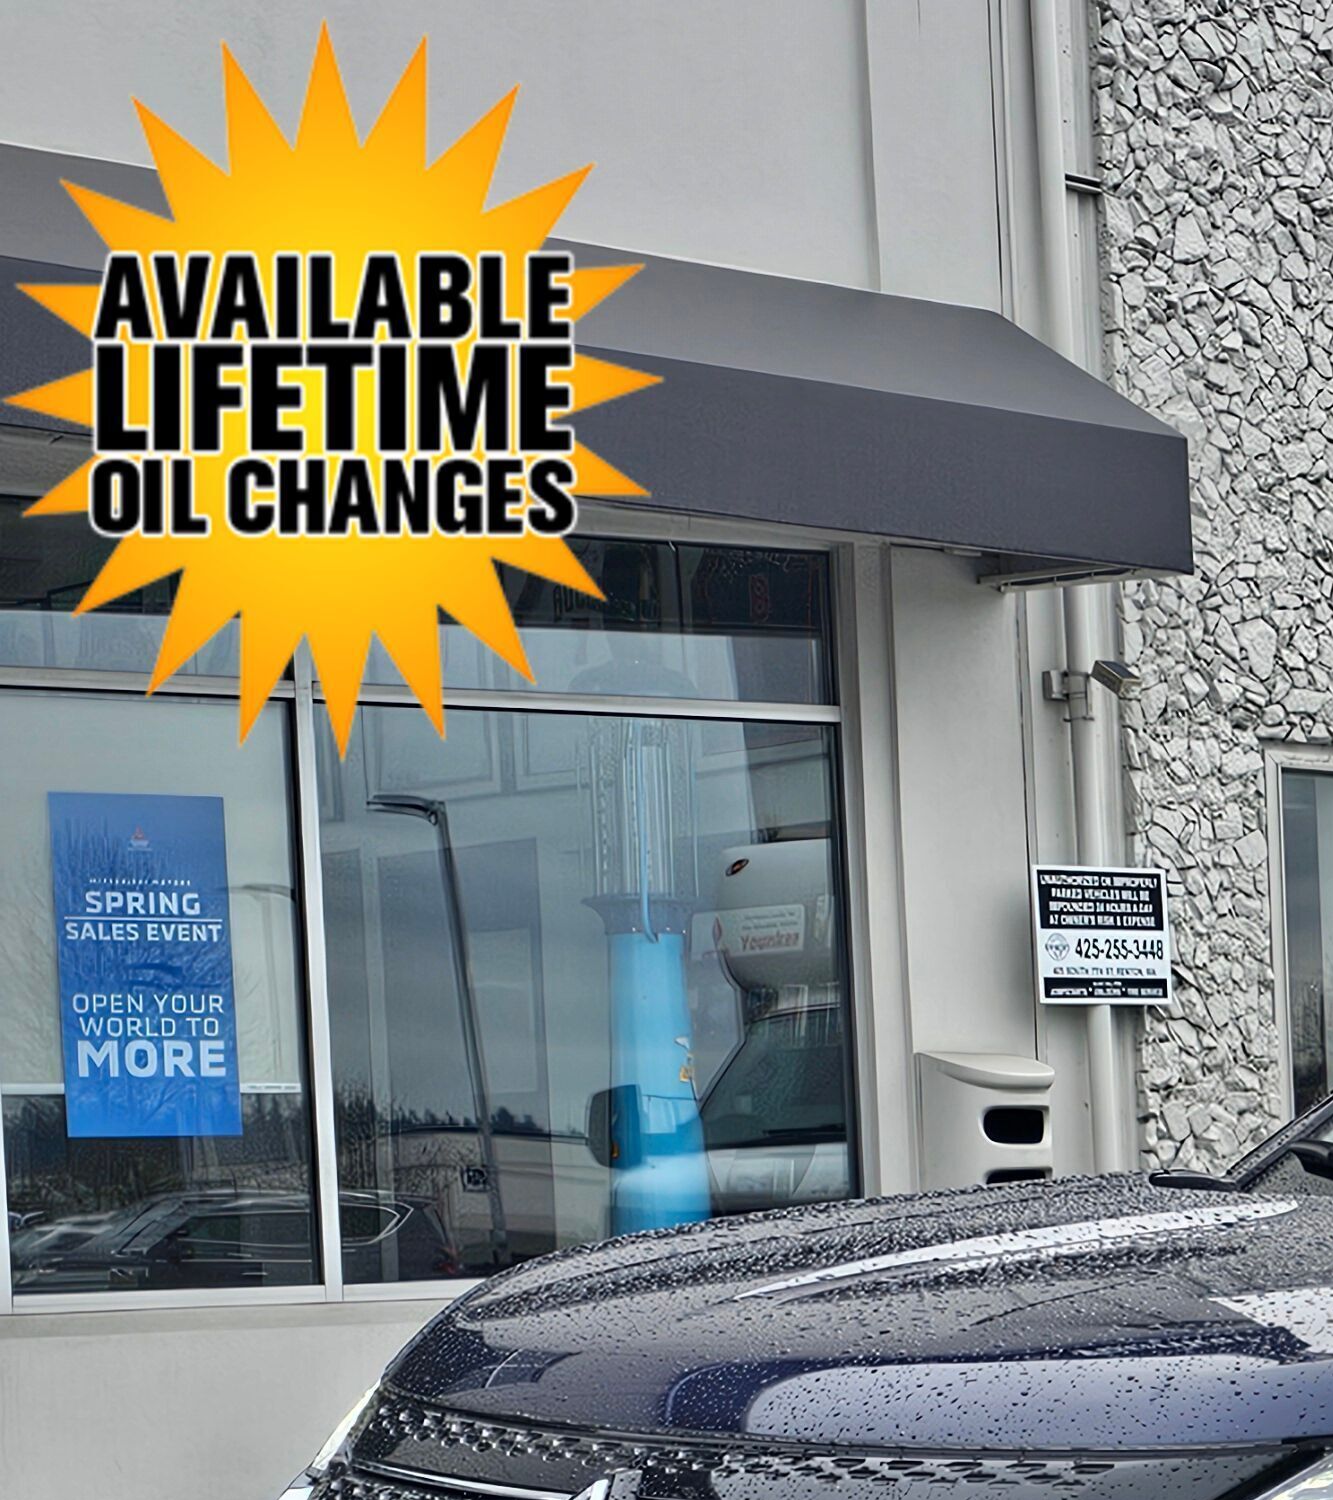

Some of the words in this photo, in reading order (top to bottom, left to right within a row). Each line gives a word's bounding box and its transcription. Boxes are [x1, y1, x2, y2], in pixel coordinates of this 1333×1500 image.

[85, 890, 201, 916] SPRING
[65, 922, 140, 941] SALES
[146, 923, 223, 943] EVENT
[1075, 938, 1164, 960] 425-255-3448
[72, 993, 144, 1014] OPEN
[153, 994, 225, 1015] YOUR
[79, 1016, 176, 1037] WORLD
[186, 1017, 219, 1037] TO
[77, 1039, 227, 1078] MORE
